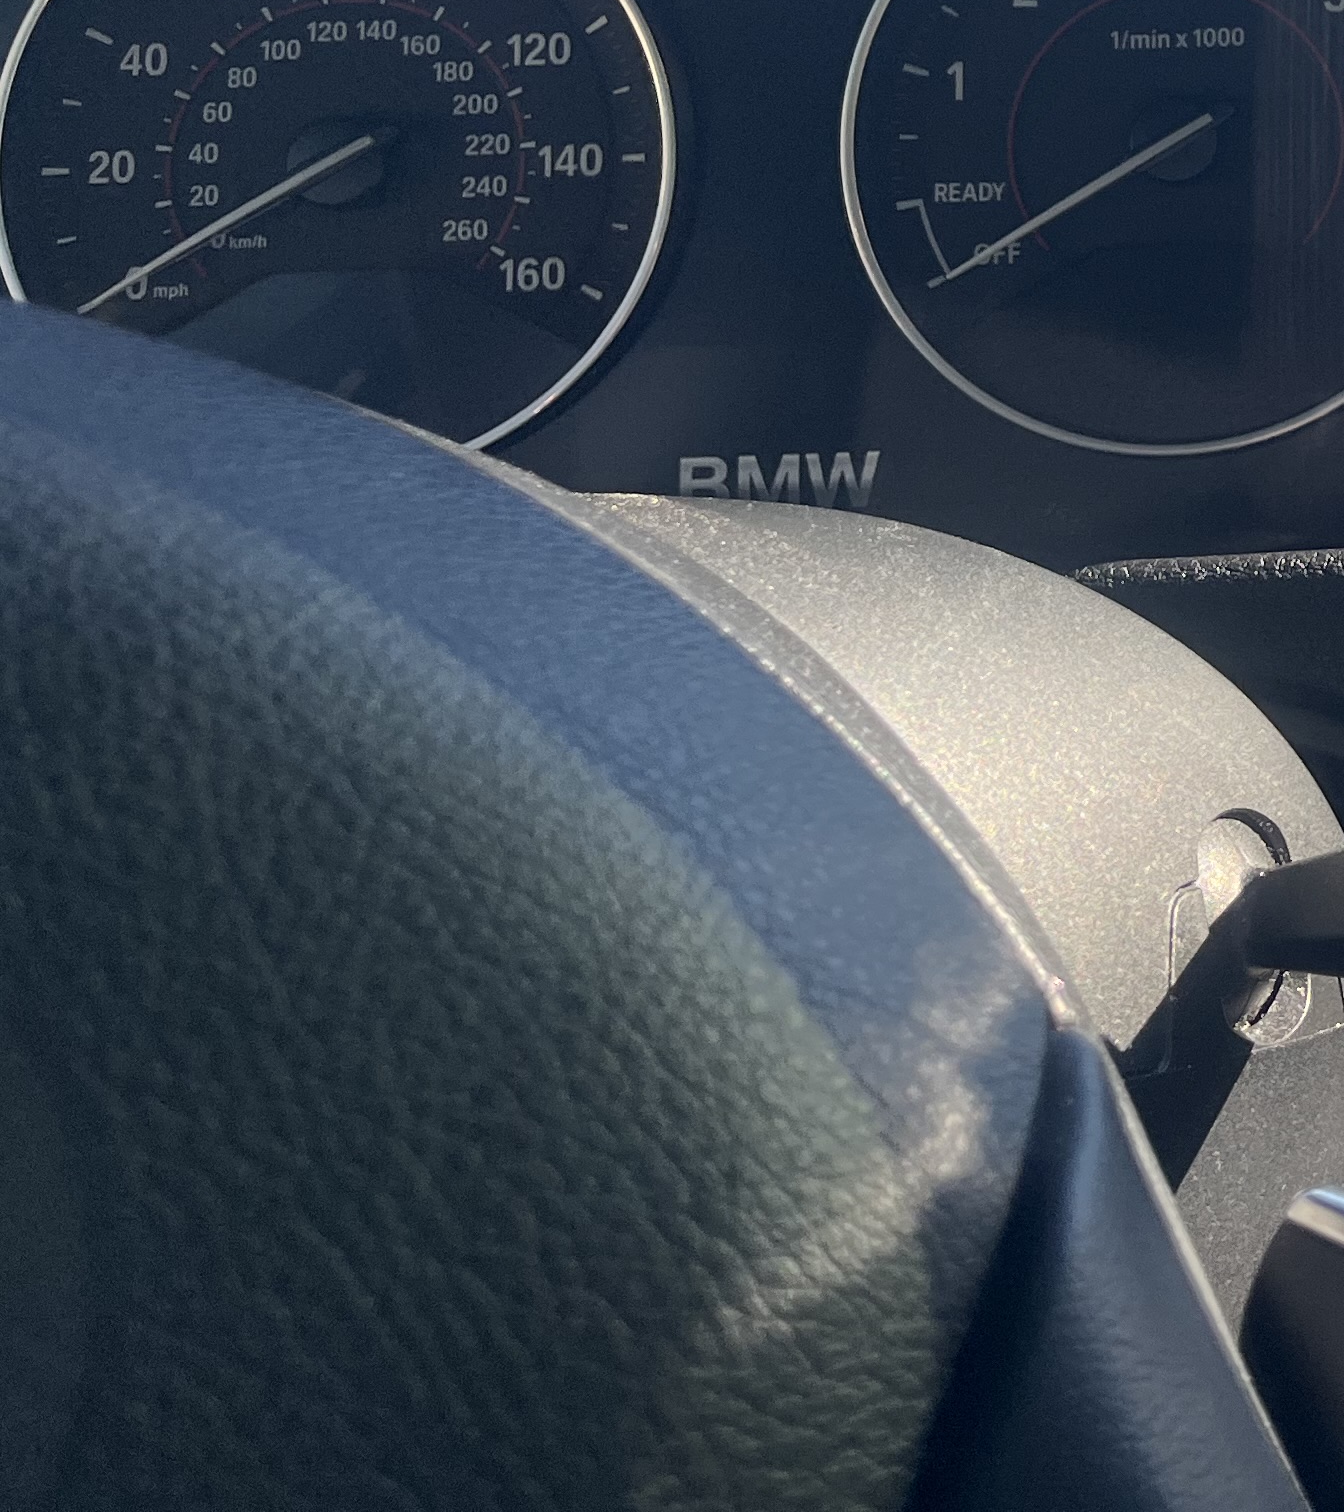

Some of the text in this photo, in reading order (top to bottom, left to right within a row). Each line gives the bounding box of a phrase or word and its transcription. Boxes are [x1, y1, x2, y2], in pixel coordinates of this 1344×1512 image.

[307, 21, 347, 42] 120
[357, 20, 396, 40] 140
[1111, 27, 1244, 51] 1/min x 1000
[261, 40, 301, 60] 100
[401, 35, 440, 55] 160
[507, 33, 571, 66] 120
[120, 43, 167, 76] 40
[228, 67, 257, 88] 80
[433, 61, 473, 81] 180
[947, 62, 963, 100] 1
[203, 102, 232, 123] 60
[453, 94, 498, 115] 200
[189, 143, 218, 163] 40
[465, 134, 510, 155] 220
[89, 150, 134, 183] 20
[539, 144, 602, 177] 140
[190, 185, 219, 206] 20
[462, 176, 507, 197] 240
[934, 183, 1005, 202] READY
[228, 233, 267, 249] km/h
[443, 220, 488, 241] 260
[500, 258, 564, 291] 160
[153, 283, 188, 300] mph
[680, 451, 880, 508] BMW
